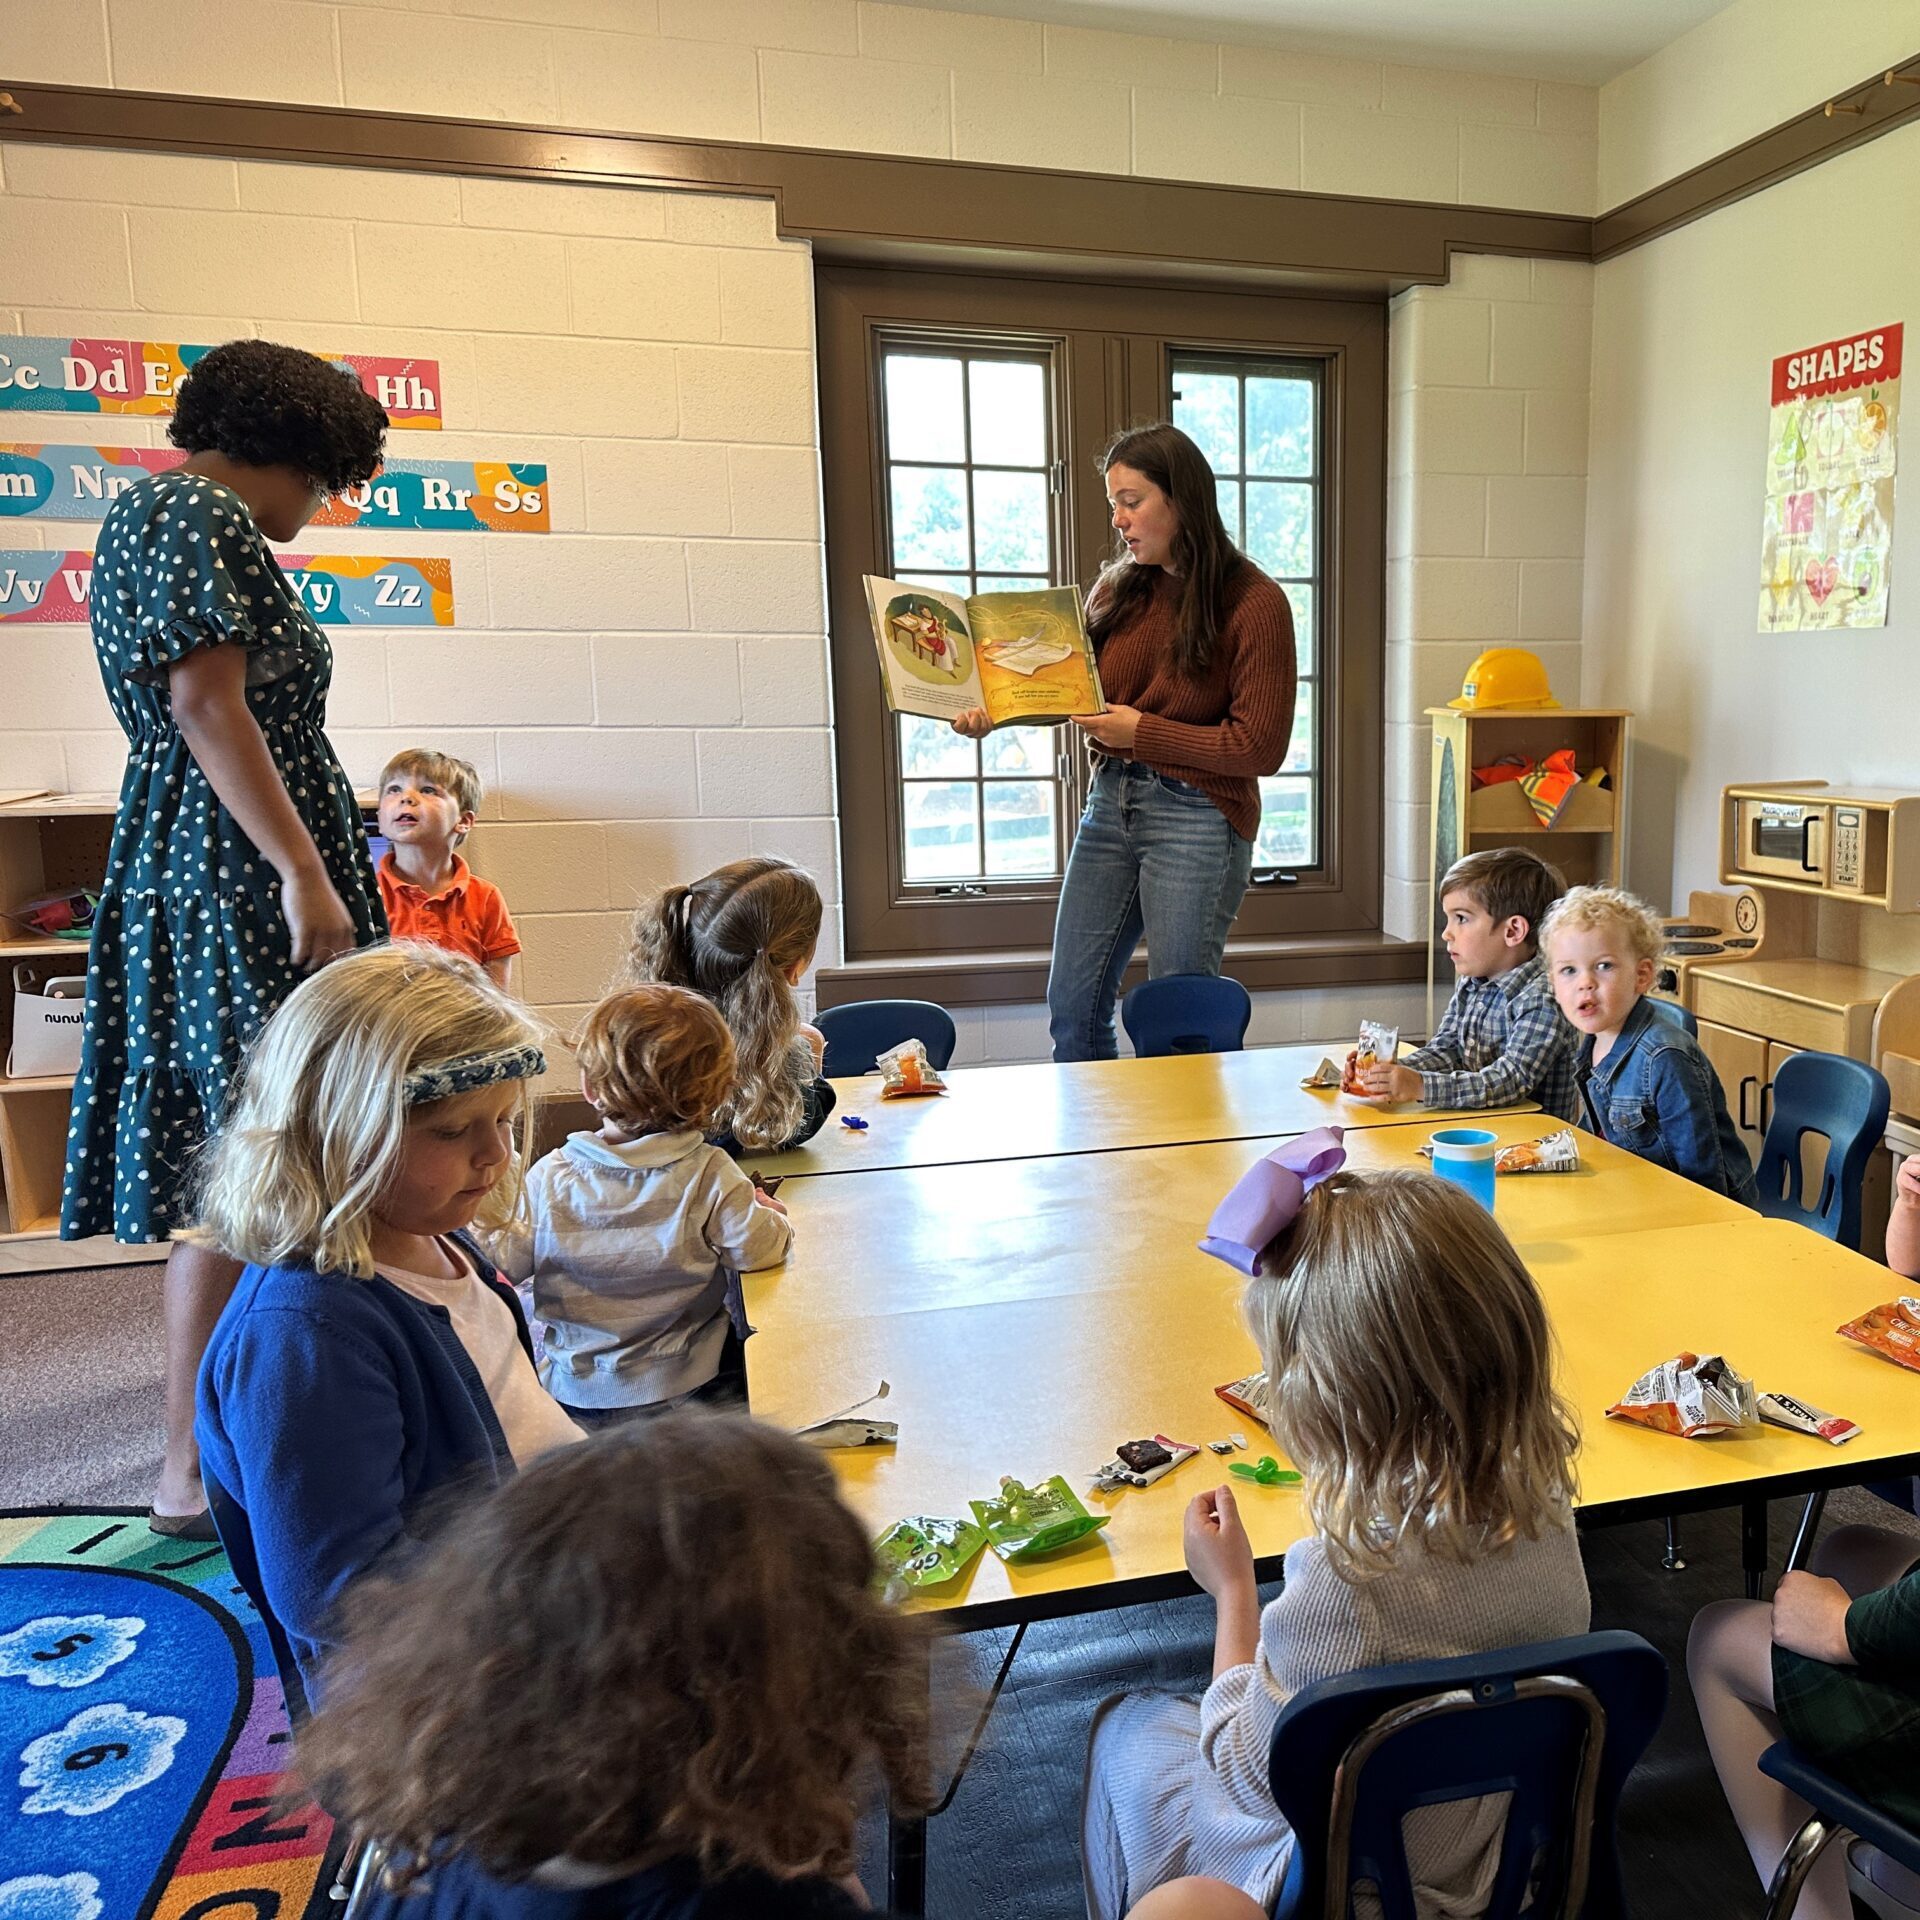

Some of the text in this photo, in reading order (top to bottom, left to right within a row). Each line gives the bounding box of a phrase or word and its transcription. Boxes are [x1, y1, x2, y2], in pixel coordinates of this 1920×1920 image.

[1787, 335, 1884, 390] SHAPES
[61, 357, 129, 393] Dd
[375, 375, 437, 411] Hh
[421, 478, 472, 511] Rr
[494, 480, 542, 514] Ss
[374, 574, 423, 607] Zz
[1838, 875, 1854, 883] START
